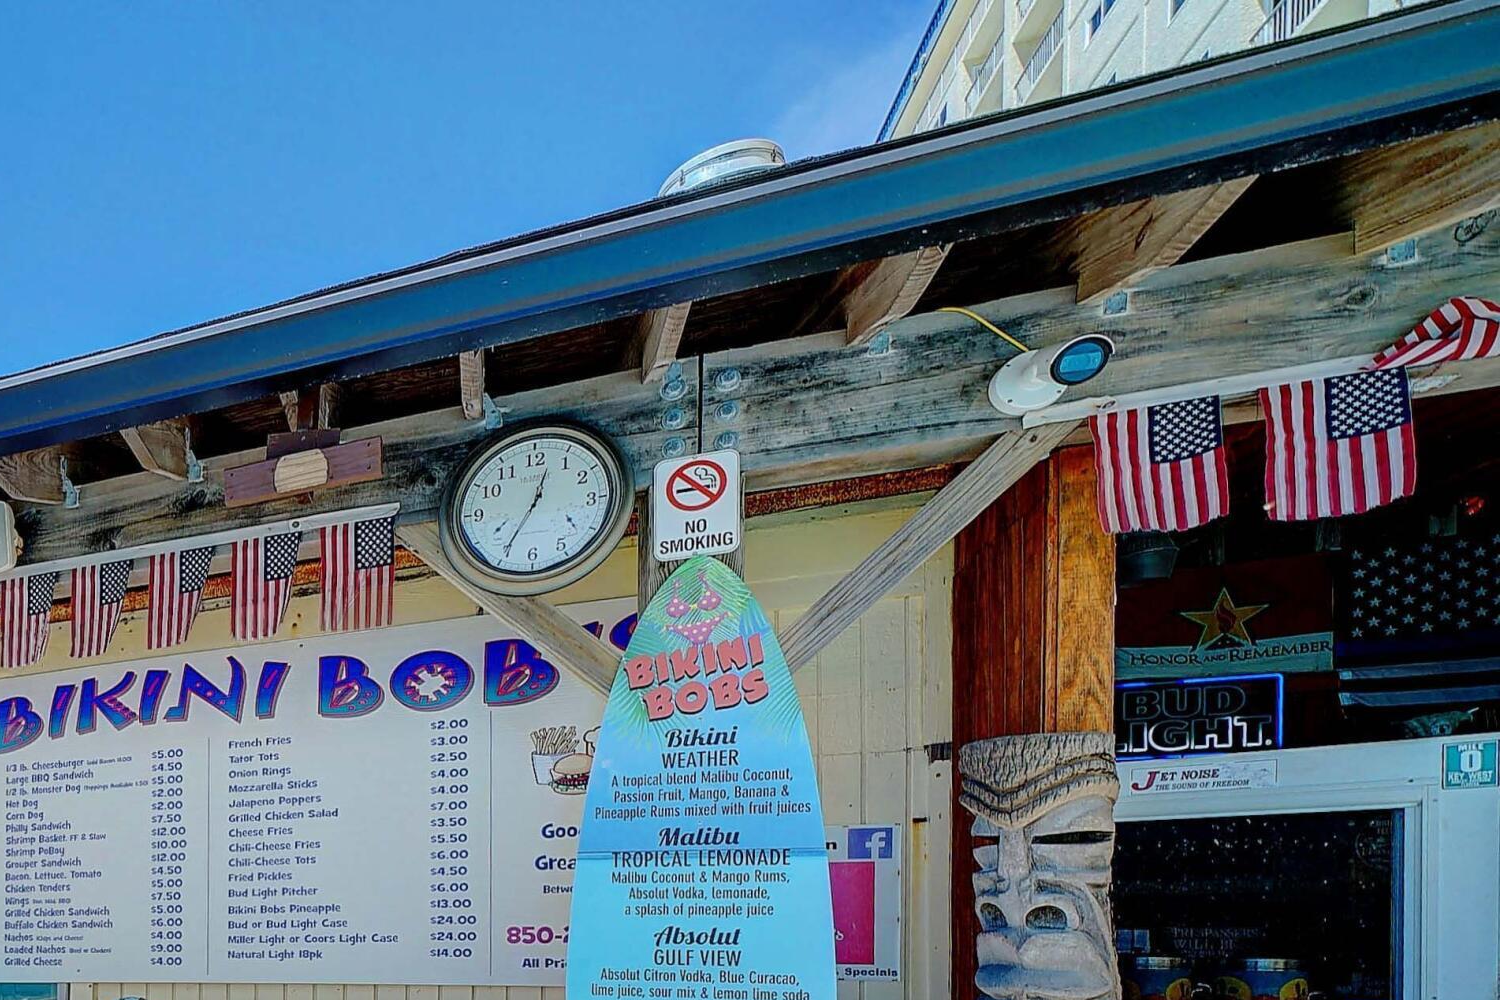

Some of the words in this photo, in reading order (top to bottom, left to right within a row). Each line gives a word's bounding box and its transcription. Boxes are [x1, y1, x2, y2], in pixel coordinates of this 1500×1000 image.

[525, 452, 545, 467] 12
[561, 457, 570, 470] 1
[498, 465, 516, 480] 11
[577, 471, 588, 484] 2
[483, 484, 501, 499] 10
[587, 492, 596, 506] 3
[474, 509, 483, 522] 9
[685, 519, 707, 534] NO
[557, 538, 566, 551] 5
[660, 532, 733, 555] SMOKING
[528, 548, 537, 561] 6
[1130, 649, 1201, 665] HONOR
[1204, 654, 1226, 662] AND
[1229, 640, 1332, 662] REMEMBER
[624, 633, 763, 690] BIKINI
[643, 669, 768, 722] BOBS
[1123, 686, 1246, 720] BUD
[229, 738, 262, 749] French
[266, 736, 291, 745] Fries
[431, 719, 469, 730] $2.00
[665, 726, 738, 747] Bikini
[151, 749, 183, 759] $5.00
[229, 754, 253, 764] Tator
[258, 753, 279, 761] Tots
[431, 735, 468, 746] $3.00
[1458, 743, 1484, 752] MILE
[151, 762, 182, 772] $4.50
[229, 769, 258, 778] Onion
[262, 766, 291, 777] Rings
[431, 752, 467, 762] $2.50
[662, 750, 739, 769] WEATHER
[1461, 750, 1482, 772] 0
[612, 776, 618, 788] A
[623, 774, 662, 788] tropical
[667, 773, 696, 785] blend
[702, 771, 738, 783] Malibu
[743, 768, 793, 782] Coconut,
[1131, 771, 1177, 791] JET
[1181, 768, 1219, 780] NOISE
[1172, 782, 1198, 790] SOUND
[1212, 779, 1249, 788] FREEDOM
[1448, 772, 1464, 784] KEY
[1468, 771, 1492, 782] WEST
[229, 782, 283, 793] Mozzarella
[287, 780, 318, 790] Sticks
[6, 800, 19, 808] Hot
[23, 799, 38, 810] Dog
[229, 797, 275, 808] Jalapeno
[279, 794, 321, 806] Poppers
[6, 812, 24, 820] Corn
[28, 811, 43, 821] Dog
[6, 823, 28, 834] Philly
[31, 821, 71, 831] Sandwich
[542, 823, 581, 839] Goo
[659, 827, 740, 846] Malibu
[865, 832, 886, 859] f
[535, 856, 576, 870] Grea
[612, 850, 691, 867] TROPICAL
[699, 849, 790, 866] LEMONADE
[228, 889, 248, 898] Bud
[252, 888, 277, 900] Light
[282, 886, 318, 896] Pitcher
[654, 926, 741, 947] Absolut
[5, 958, 30, 966] Grilled
[33, 958, 62, 966] Cheese
[228, 949, 264, 960] Natural
[268, 950, 295, 962] Light
[299, 950, 323, 960] 18pk
[431, 948, 472, 958] $14.00
[654, 949, 694, 966] GULF
[700, 950, 742, 967] VIEW
[522, 958, 541, 969] All
[545, 957, 567, 969] Pri
[845, 968, 898, 977] Specials
